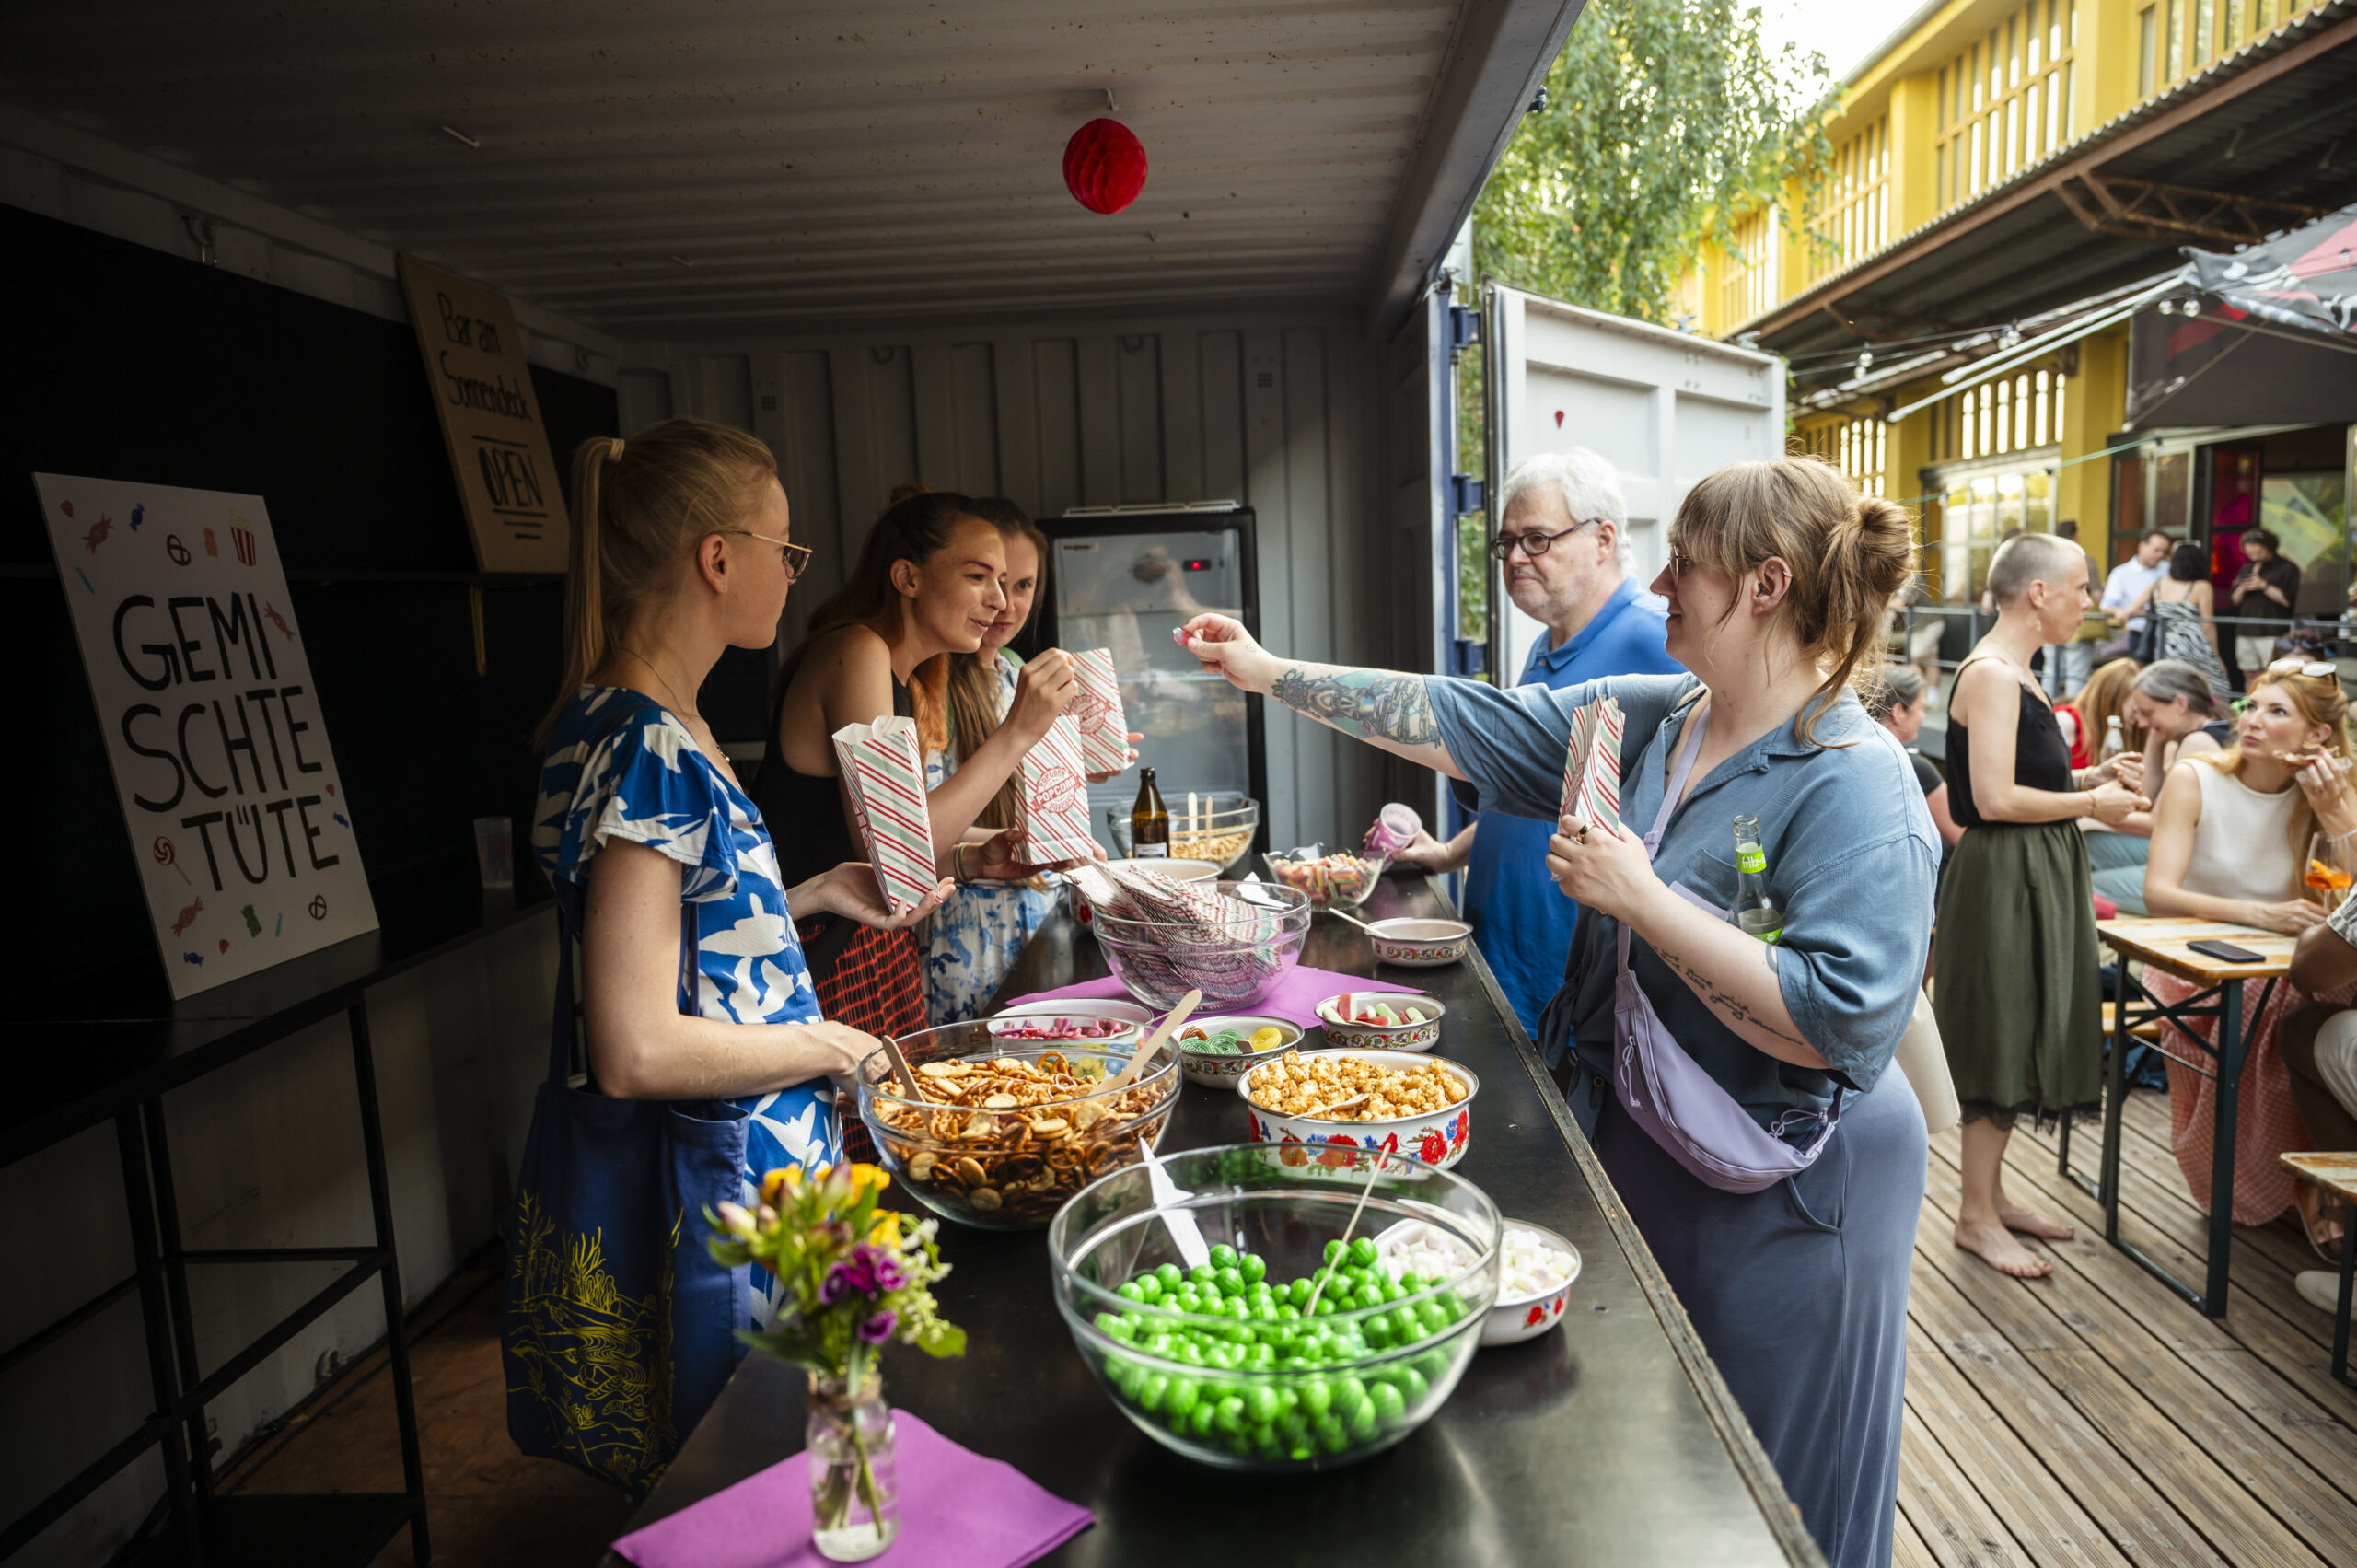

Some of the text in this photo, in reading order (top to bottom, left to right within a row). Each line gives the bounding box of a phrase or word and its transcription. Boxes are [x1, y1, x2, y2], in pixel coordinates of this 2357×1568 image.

[437, 291, 502, 354] Bar am
[440, 350, 534, 422] Sonnendeck
[478, 447, 545, 508] OPEN
[112, 591, 277, 691] GEMI
[121, 685, 322, 813] SCHTE
[1036, 776, 1076, 806] POPCORN
[181, 795, 340, 891] TÜTE
